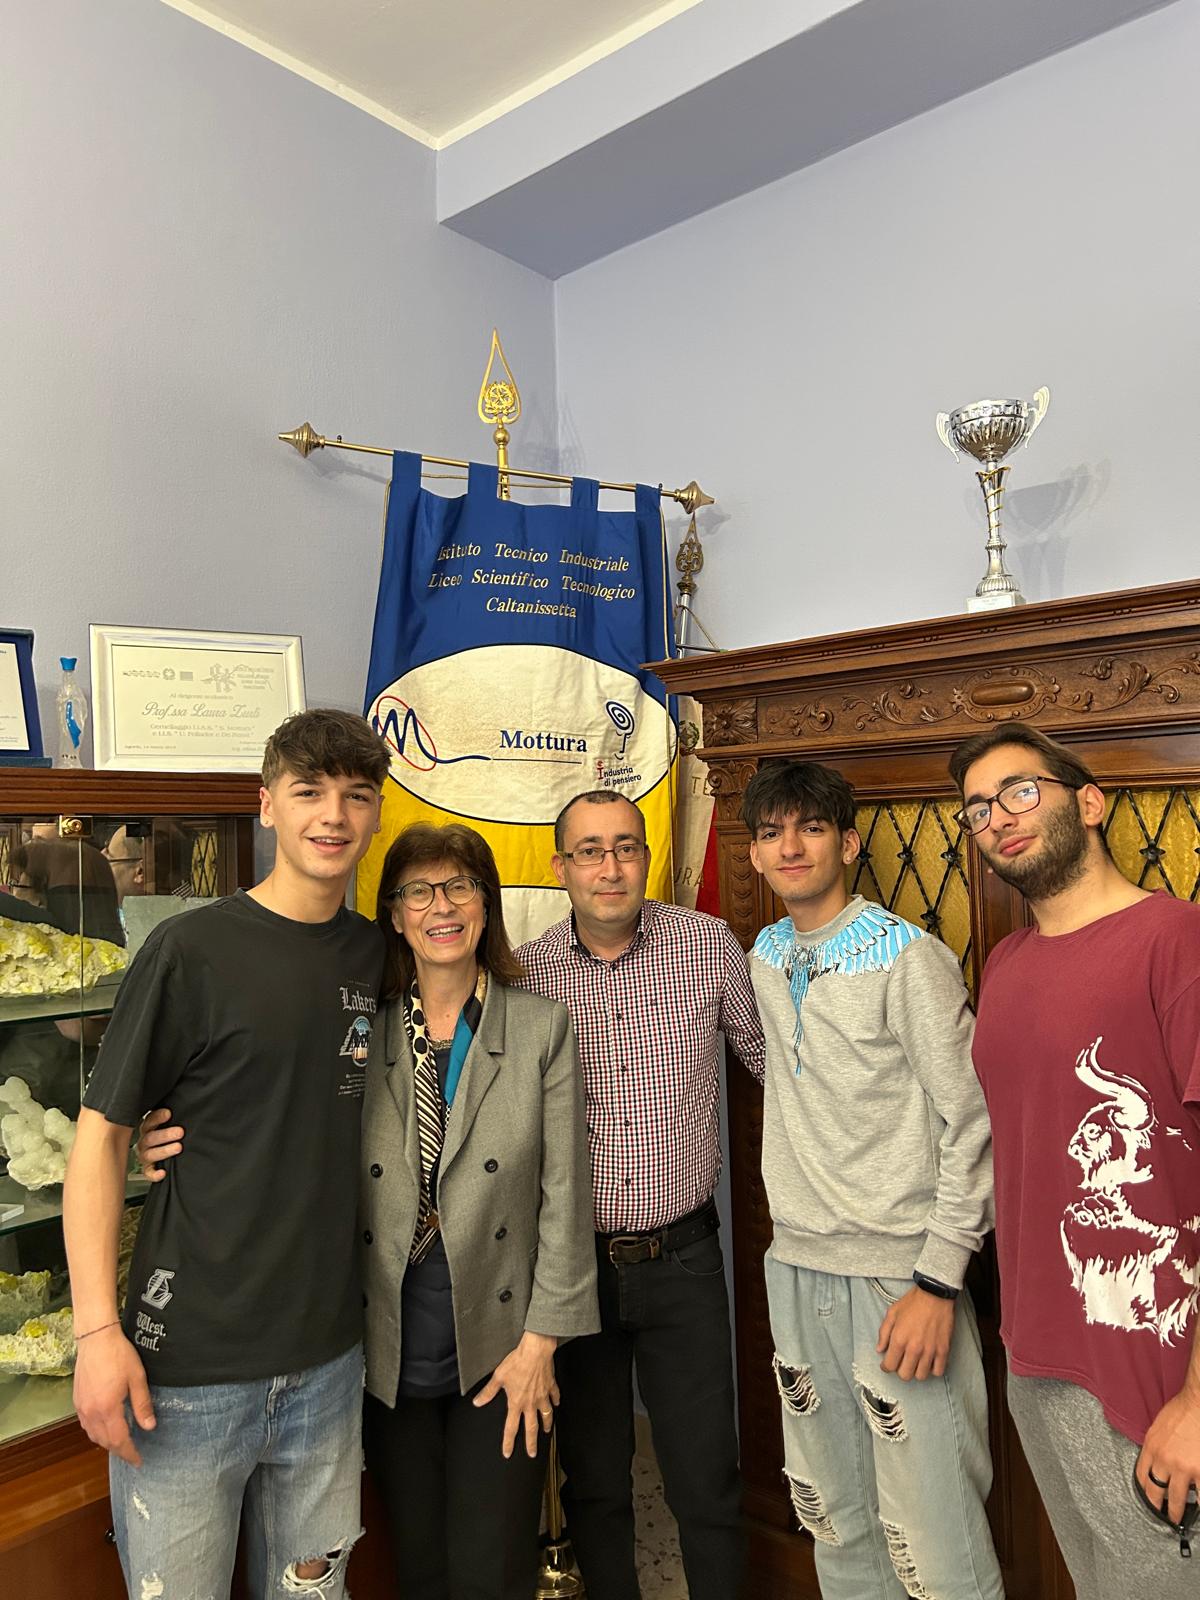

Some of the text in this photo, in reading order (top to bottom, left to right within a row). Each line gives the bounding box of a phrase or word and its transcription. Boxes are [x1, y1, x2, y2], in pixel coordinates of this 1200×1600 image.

[494, 543, 548, 563] Tecnico
[559, 550, 629, 572] Industriale
[428, 569, 636, 601] Liceo Scientifico Tecnologico
[486, 596, 577, 618] Caltanissetta
[500, 730, 588, 752] Mottura
[604, 774, 642, 788] di pensiero
[339, 986, 377, 1014] Lakers
[136, 1311, 166, 1337] West.
